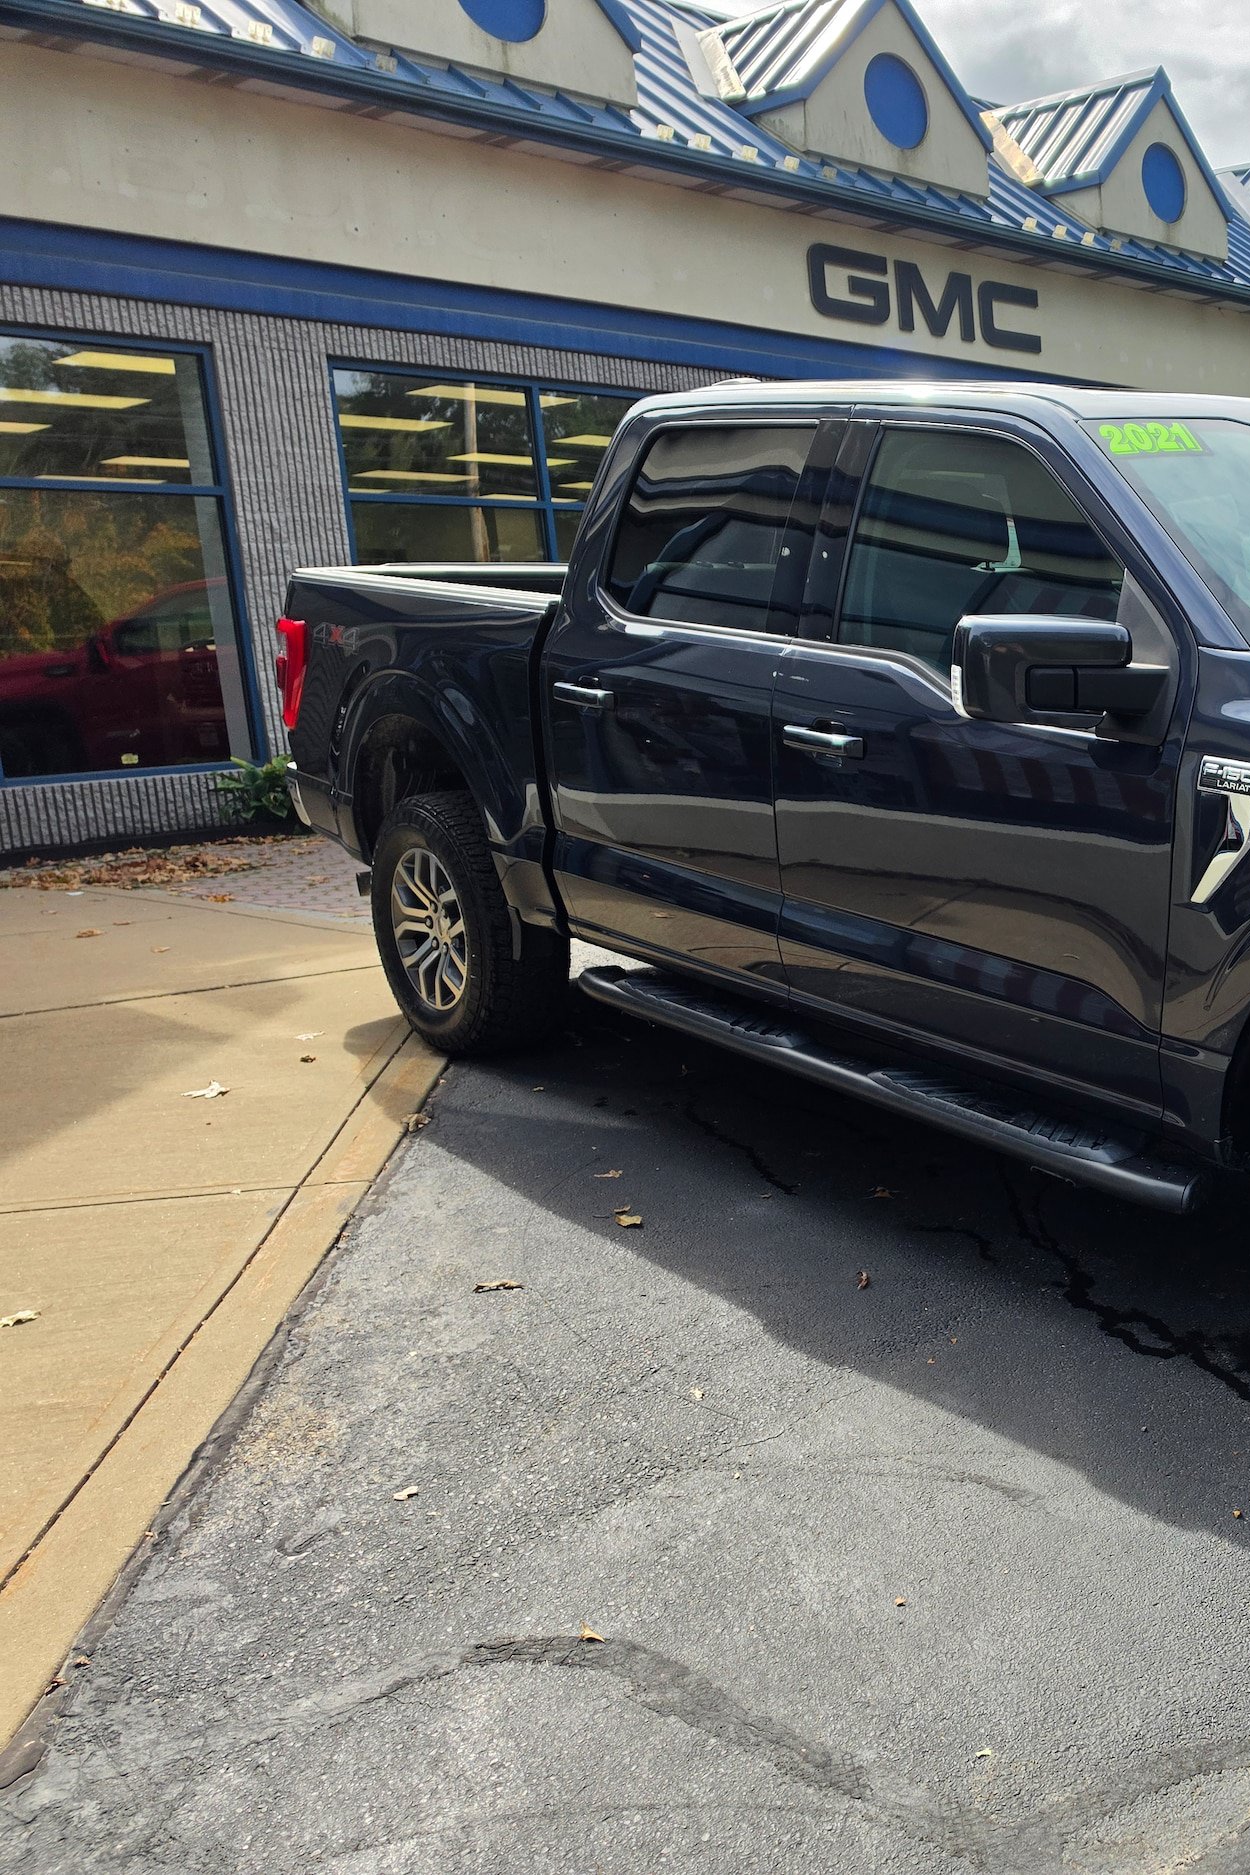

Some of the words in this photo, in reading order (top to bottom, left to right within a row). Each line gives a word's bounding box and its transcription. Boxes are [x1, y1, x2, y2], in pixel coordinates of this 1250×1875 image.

[807, 242, 1041, 353] GMC
[1098, 422, 1202, 455] 2021
[1216, 779, 1250, 792] LARIAT
